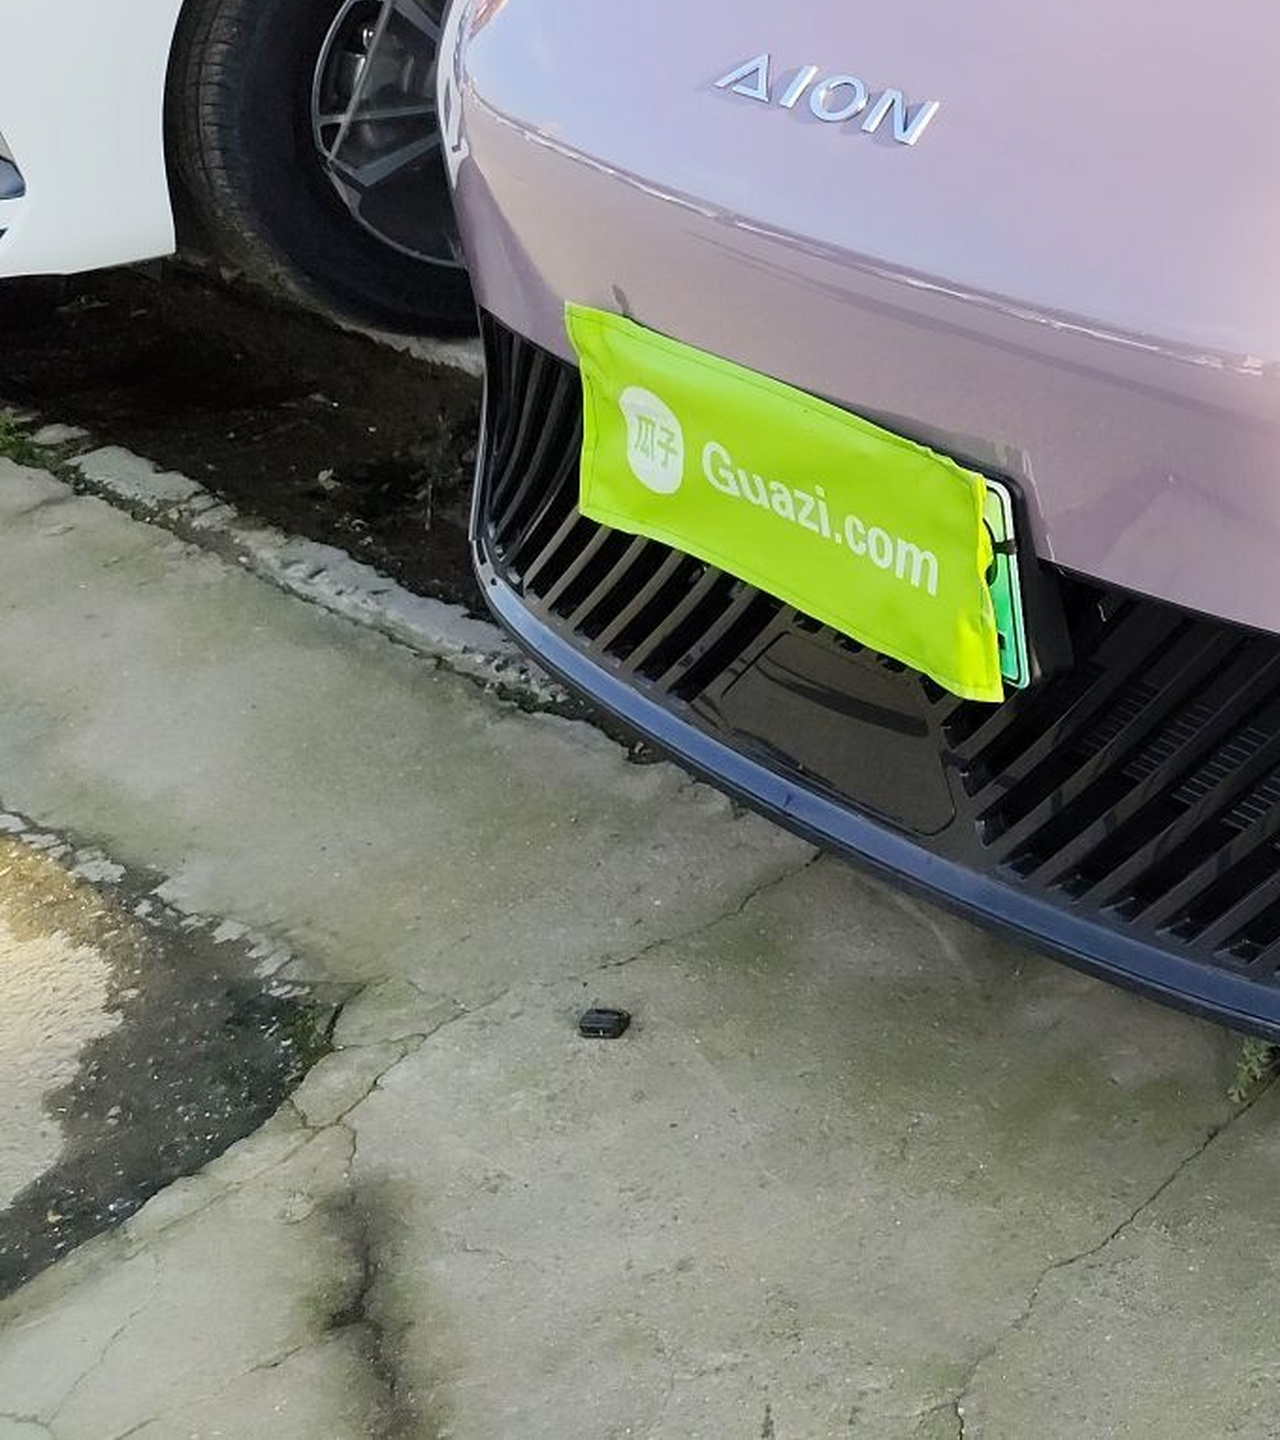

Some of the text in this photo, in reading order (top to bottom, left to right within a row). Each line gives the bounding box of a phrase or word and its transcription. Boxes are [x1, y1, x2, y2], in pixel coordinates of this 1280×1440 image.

[712, 53, 940, 146] AION
[633, 415, 679, 469] 瓜子
[701, 440, 940, 597] Guazi.com
